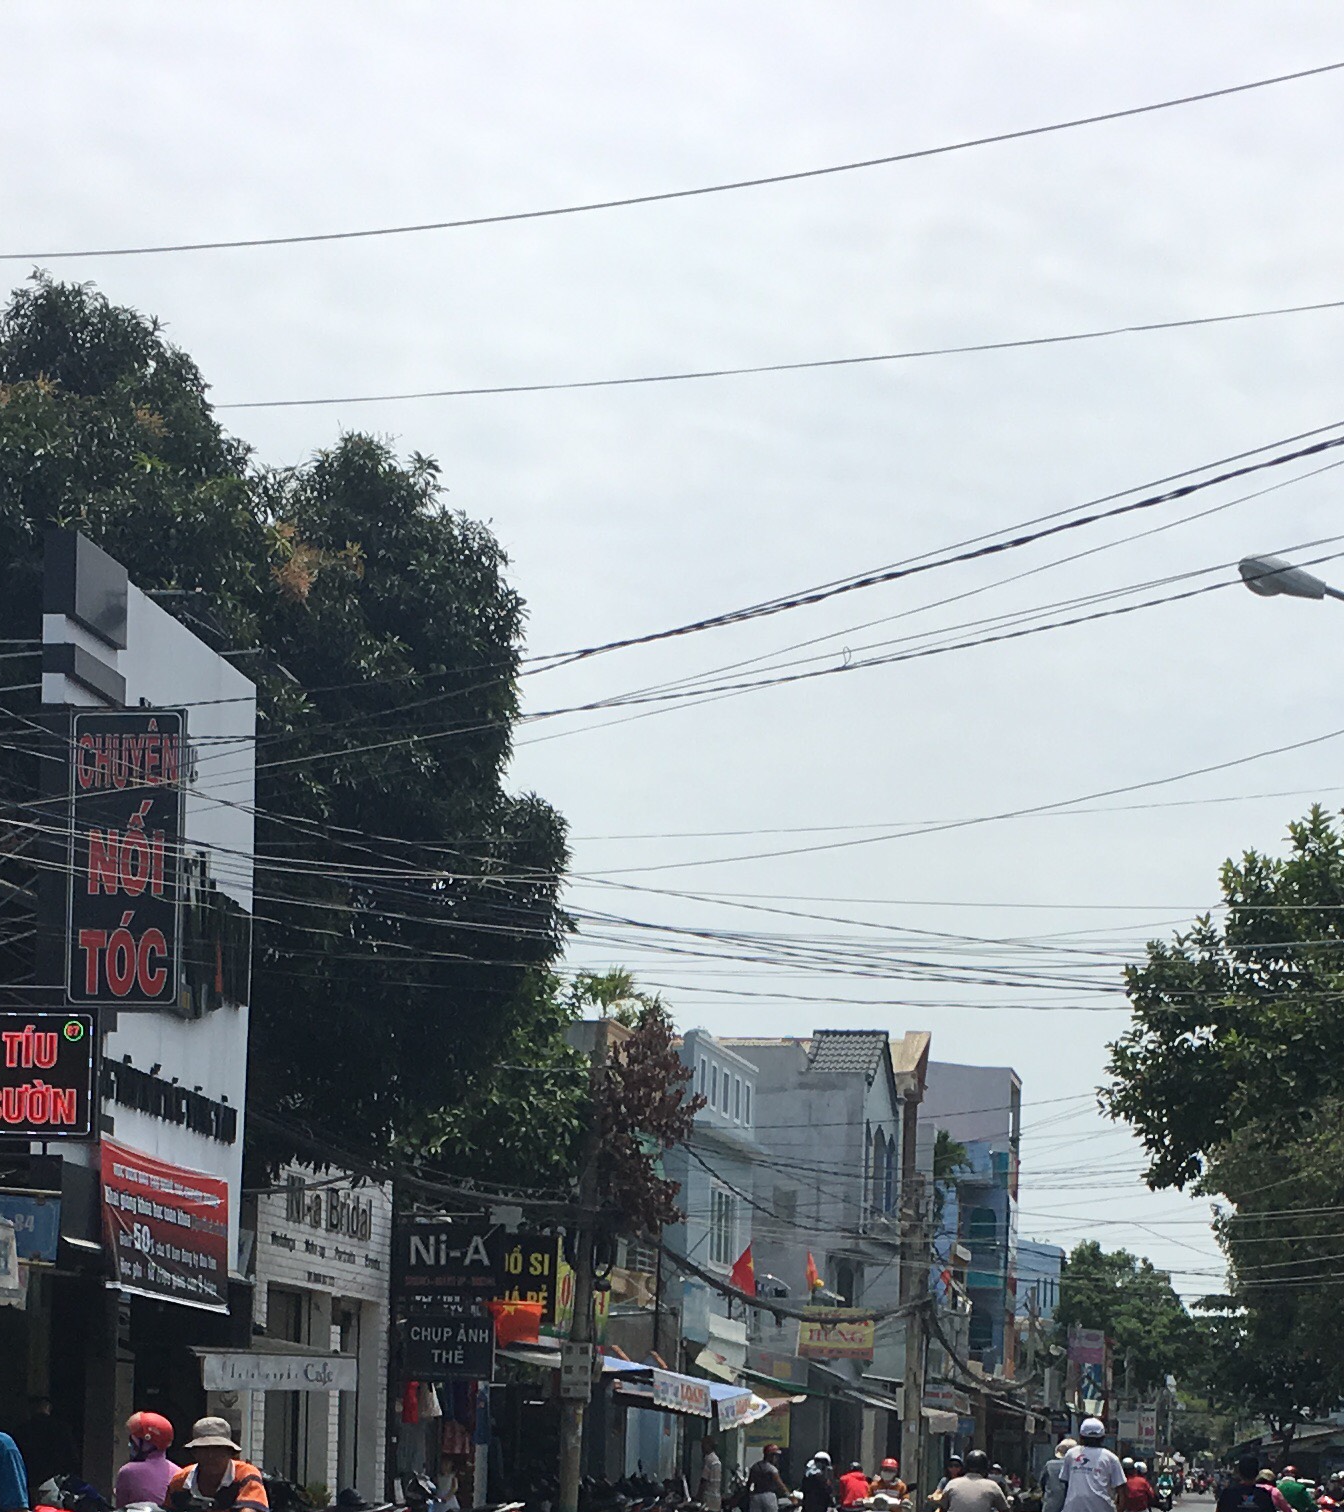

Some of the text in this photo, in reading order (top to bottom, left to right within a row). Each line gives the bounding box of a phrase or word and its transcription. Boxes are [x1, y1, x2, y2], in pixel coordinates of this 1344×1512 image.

[77, 718, 179, 790] CHUYÊN
[87, 800, 165, 897] NỐI
[78, 911, 168, 998] TÓC
[1, 1024, 59, 1069] TÍU
[409, 1233, 491, 1267] Ni-A
[410, 1322, 490, 1344] CHỤP ẢNH
